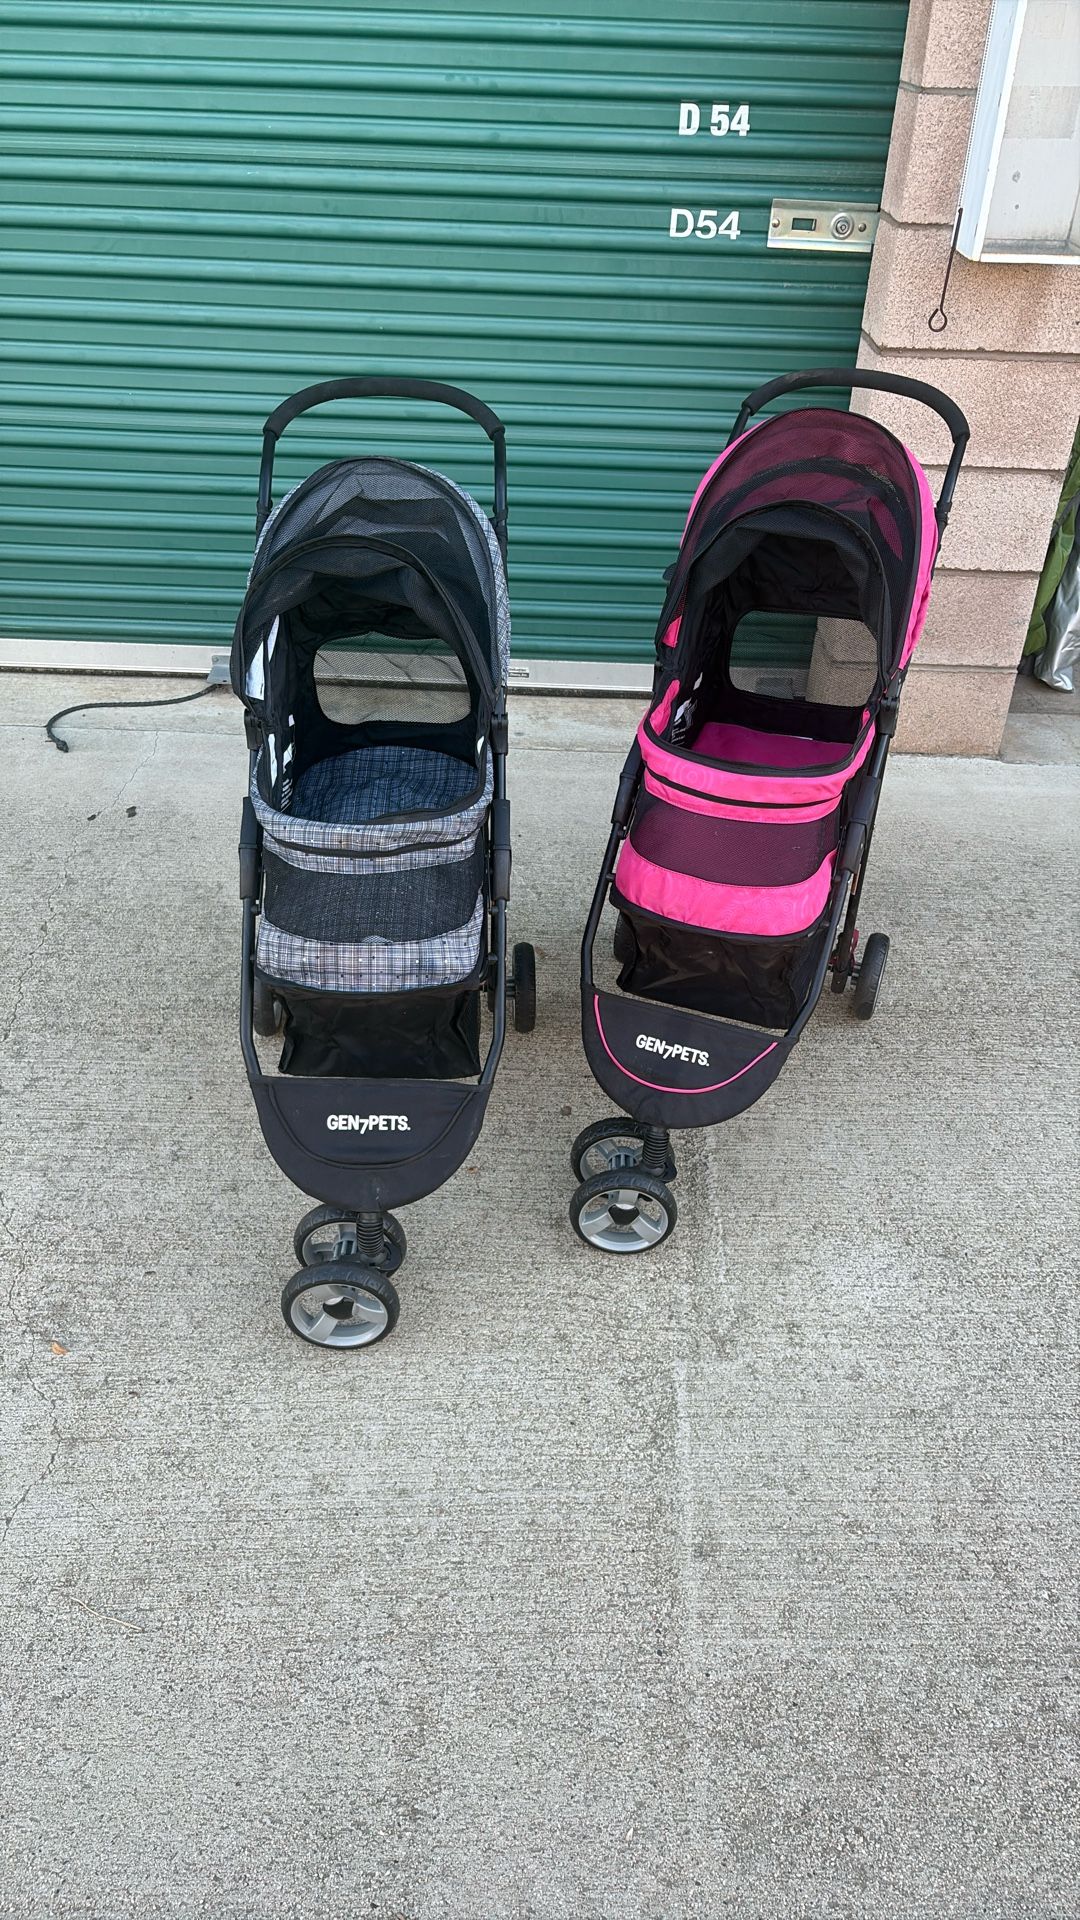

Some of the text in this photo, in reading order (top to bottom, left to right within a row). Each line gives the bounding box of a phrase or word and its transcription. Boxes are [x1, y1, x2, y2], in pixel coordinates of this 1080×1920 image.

[678, 103, 750, 137] D 54
[669, 208, 741, 240] D54
